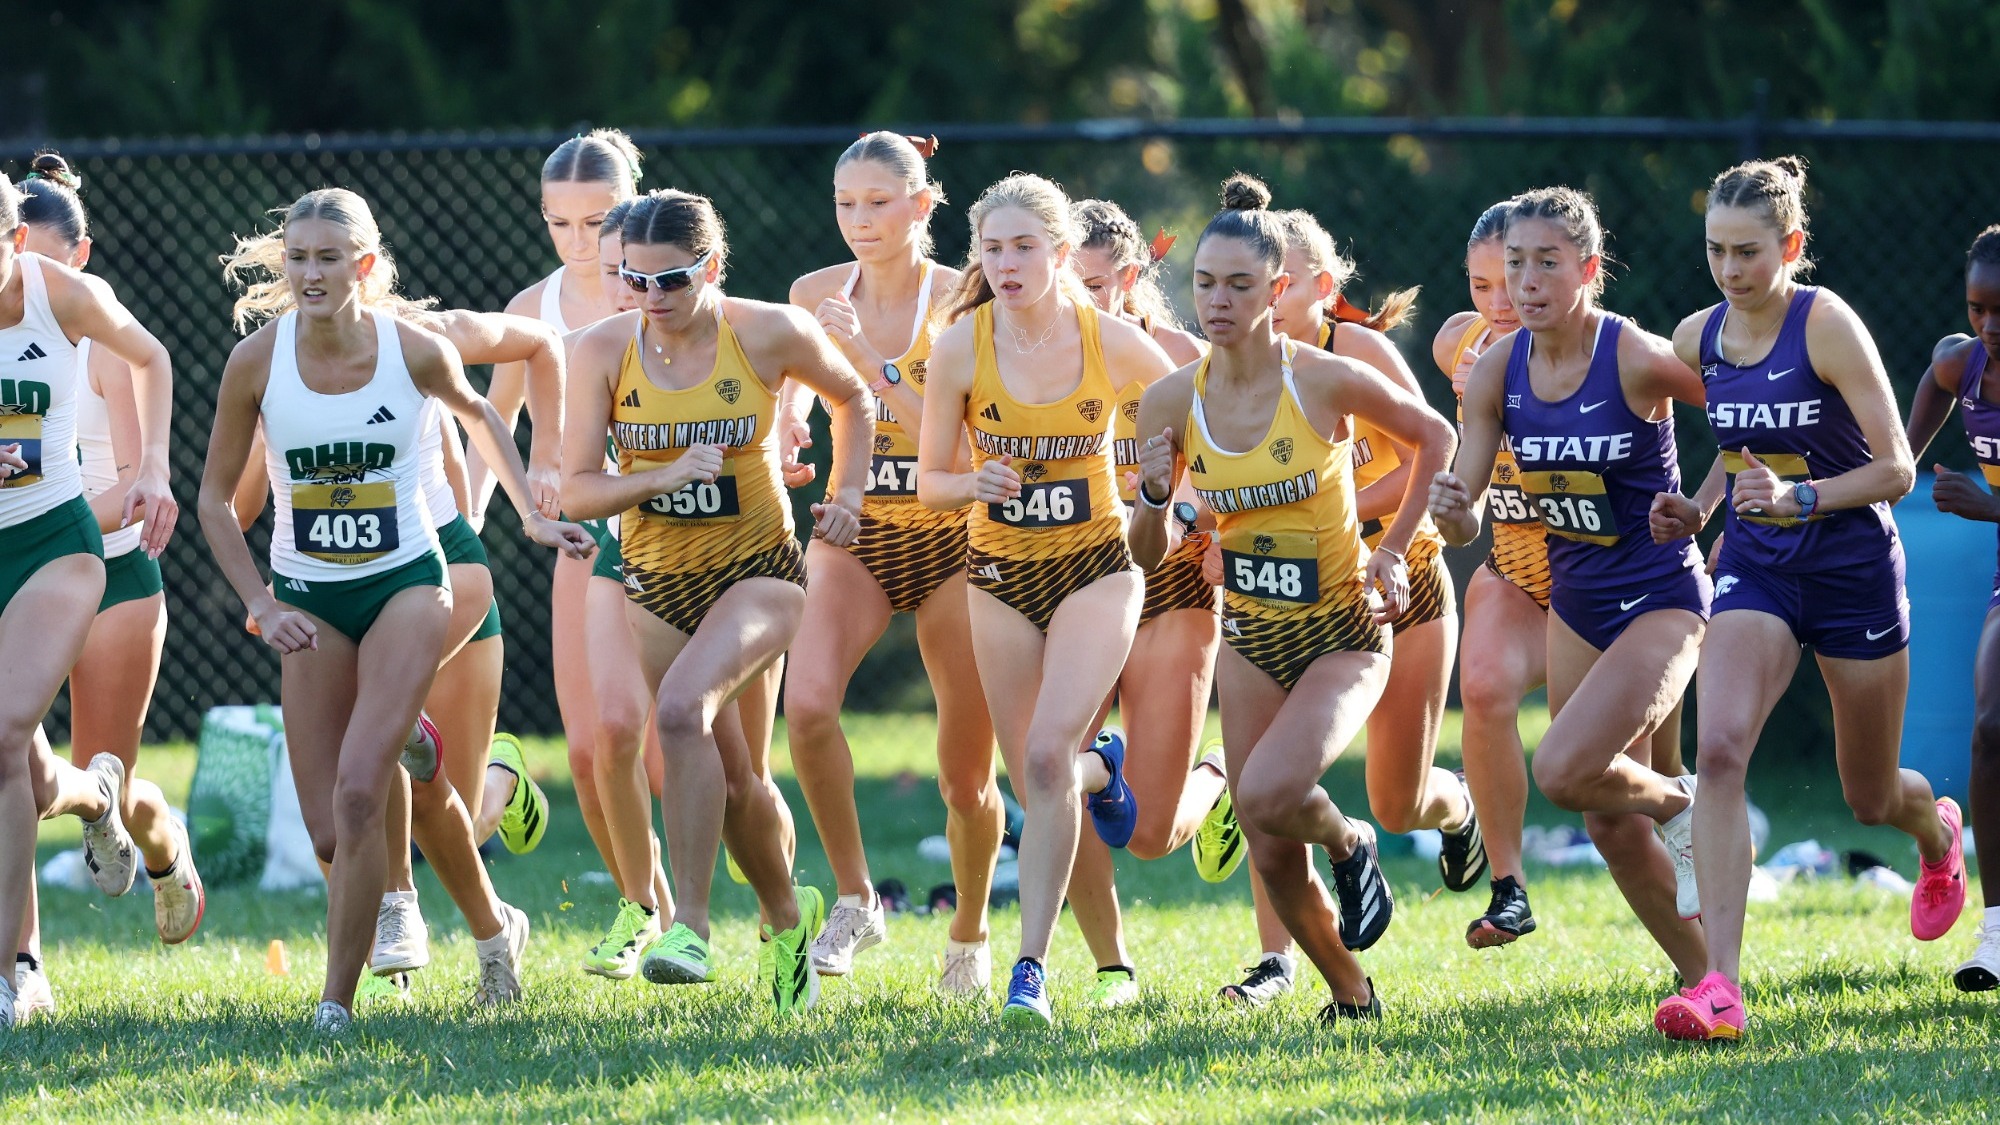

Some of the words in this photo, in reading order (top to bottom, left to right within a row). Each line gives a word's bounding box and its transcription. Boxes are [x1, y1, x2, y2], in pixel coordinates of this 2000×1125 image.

[674, 414, 757, 449] MICHIGAN
[1706, 399, 1822, 429] -STATE
[285, 442, 396, 480] OHIO
[650, 482, 722, 515] 550
[1002, 486, 1075, 522] 546
[1239, 469, 1318, 511] MICHIGAN
[308, 513, 382, 549] 403
[1539, 497, 1601, 532] 316
[1235, 557, 1302, 598] 548
